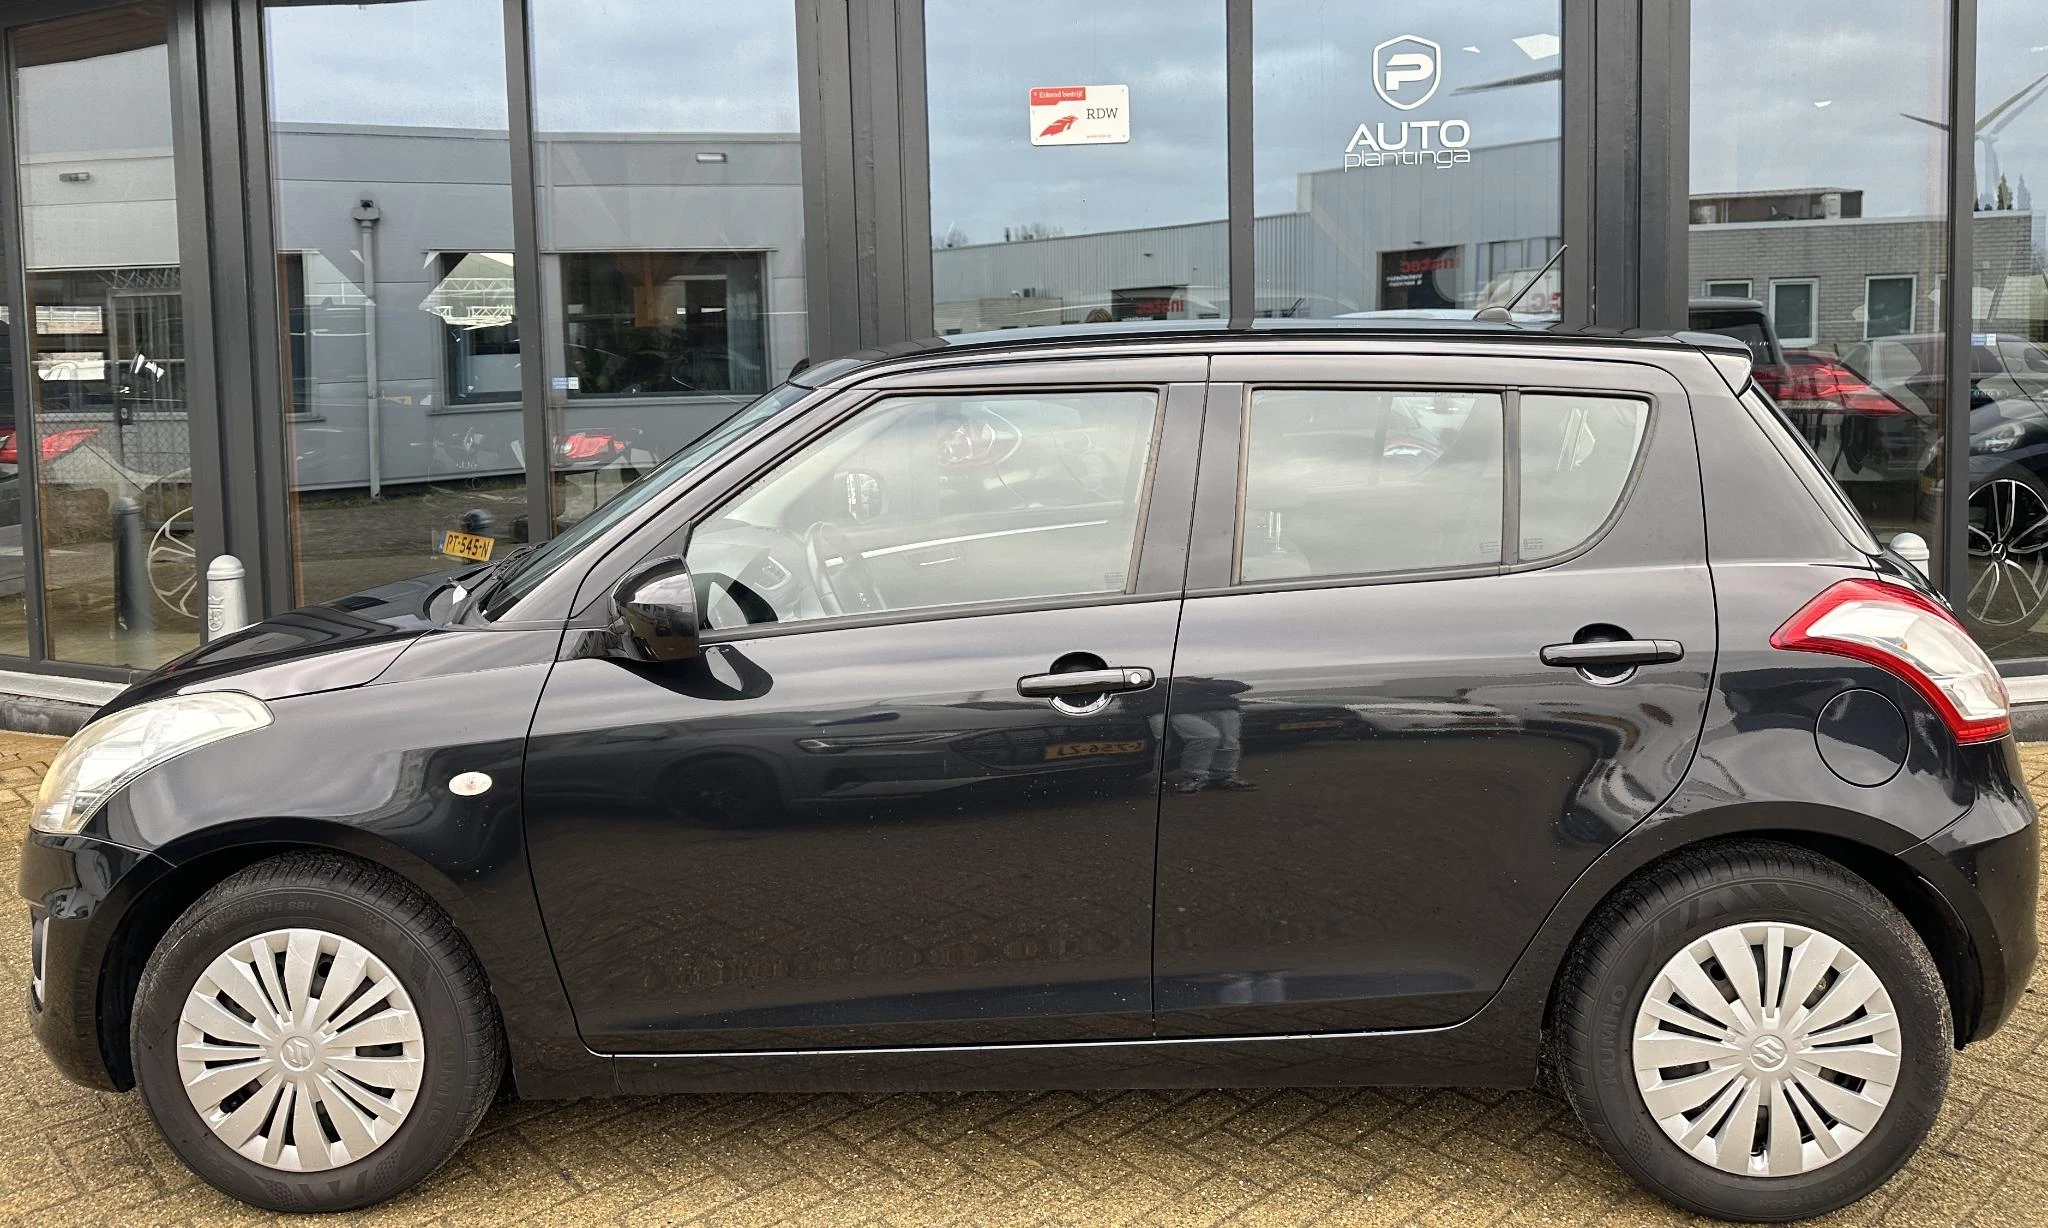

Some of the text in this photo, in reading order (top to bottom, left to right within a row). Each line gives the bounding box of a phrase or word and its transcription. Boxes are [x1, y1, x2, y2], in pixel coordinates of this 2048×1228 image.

[1039, 90, 1084, 99] Erkend bedrijf
[1086, 107, 1119, 120] RDW
[1345, 119, 1471, 153] AUTO
[1344, 148, 1471, 173] plantinga
[445, 534, 490, 559] PT-545-N
[1600, 984, 1627, 1086] KUMHO
